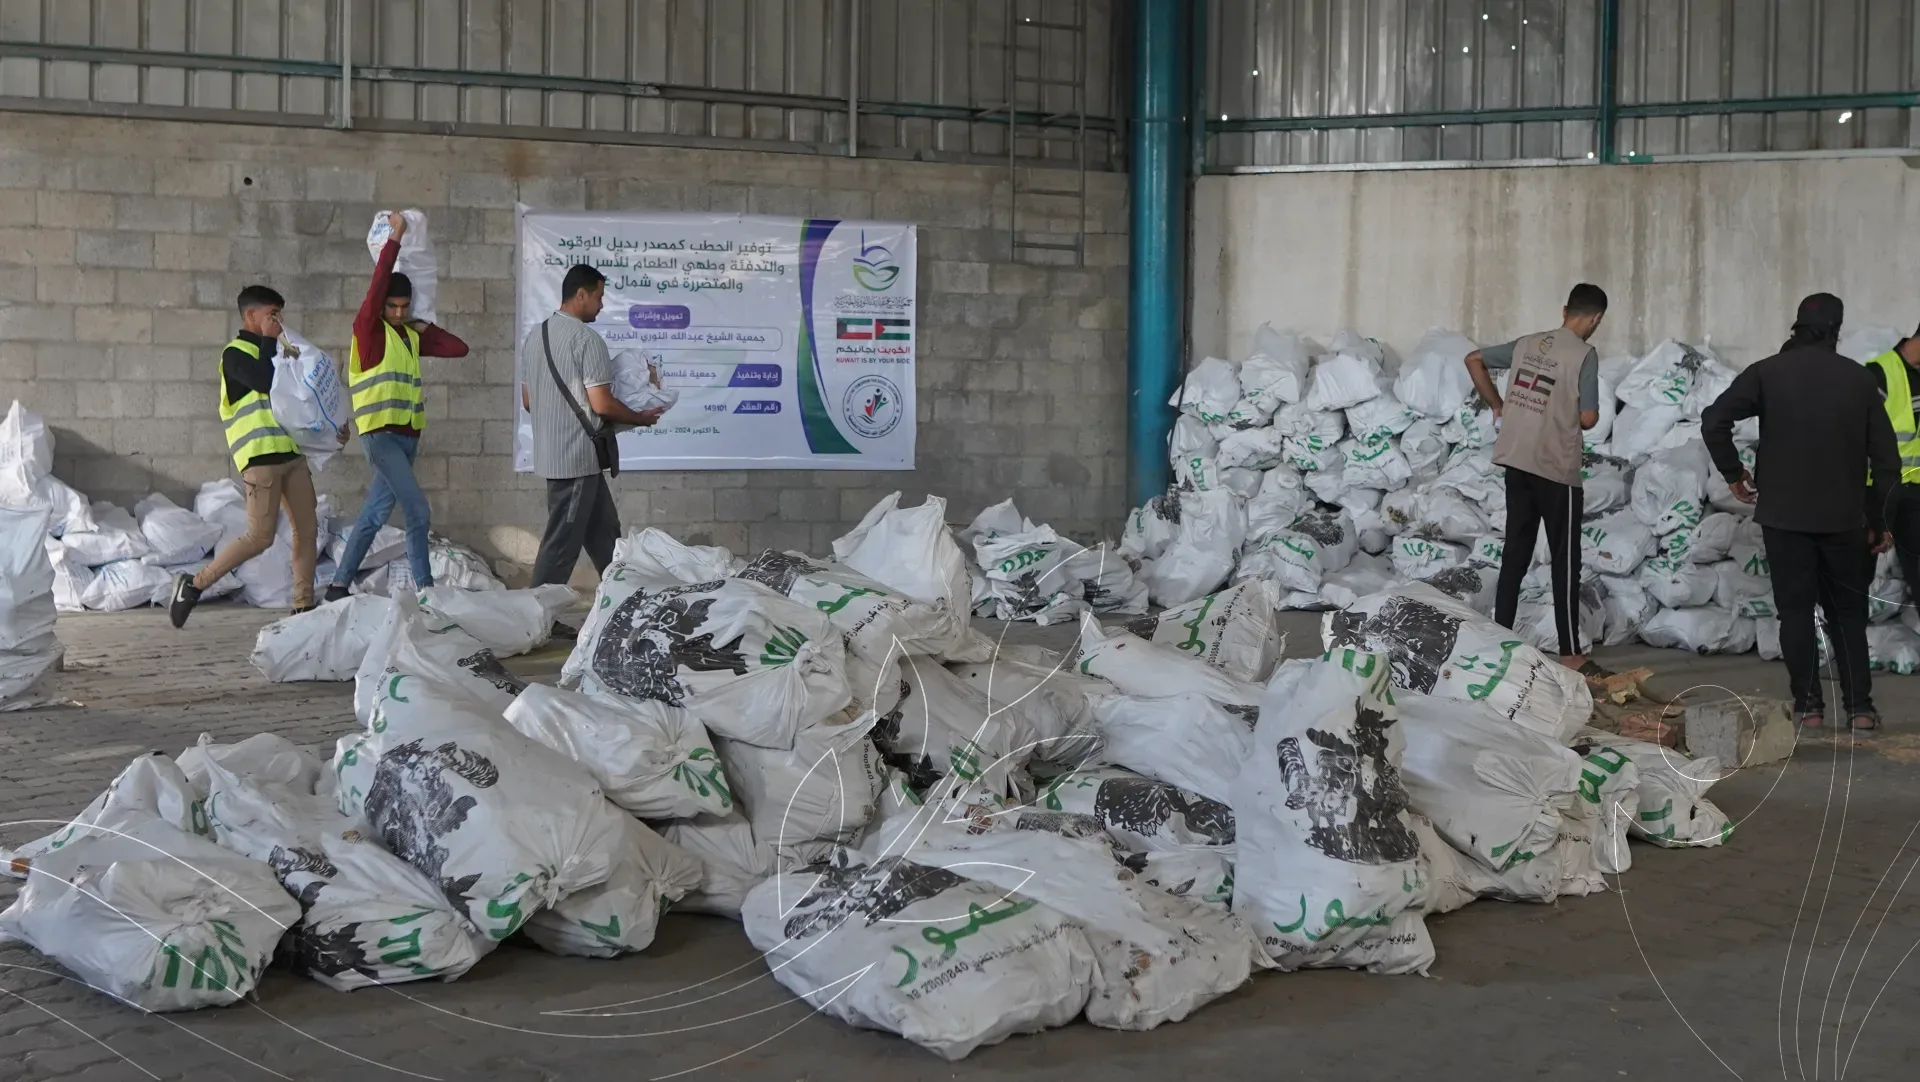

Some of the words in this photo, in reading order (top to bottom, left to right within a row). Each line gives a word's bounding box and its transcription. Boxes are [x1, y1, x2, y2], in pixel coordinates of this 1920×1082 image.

[558, 236, 602, 252] للوقود
[606, 237, 638, 252] بديل
[643, 239, 686, 252] كمصدر
[690, 240, 733, 255] الحطب
[737, 242, 772, 256] توفير
[544, 254, 590, 269] النازحة
[595, 253, 629, 271] للأسر
[633, 259, 677, 271] الطعام
[681, 260, 725, 275] وطهي
[730, 259, 785, 276] والتدفئة
[614, 273, 651, 289] شمال
[656, 277, 679, 293] في
[682, 276, 744, 293] والمتضررة
[662, 312, 684, 322] تمويل
[605, 331, 638, 342] الخيرية
[640, 331, 668, 343] النوري
[671, 332, 704, 342] عبدالله
[706, 332, 733, 344] الشيخ
[736, 333, 766, 344] جمعية
[836, 346, 876, 354] بجانبكم
[877, 346, 911, 354] الكويت
[690, 371, 717, 382] جمعية
[736, 370, 762, 381] وتنفيذ
[762, 370, 778, 382] إدارة
[740, 402, 762, 412] العقد
[764, 403, 778, 412] رقم
